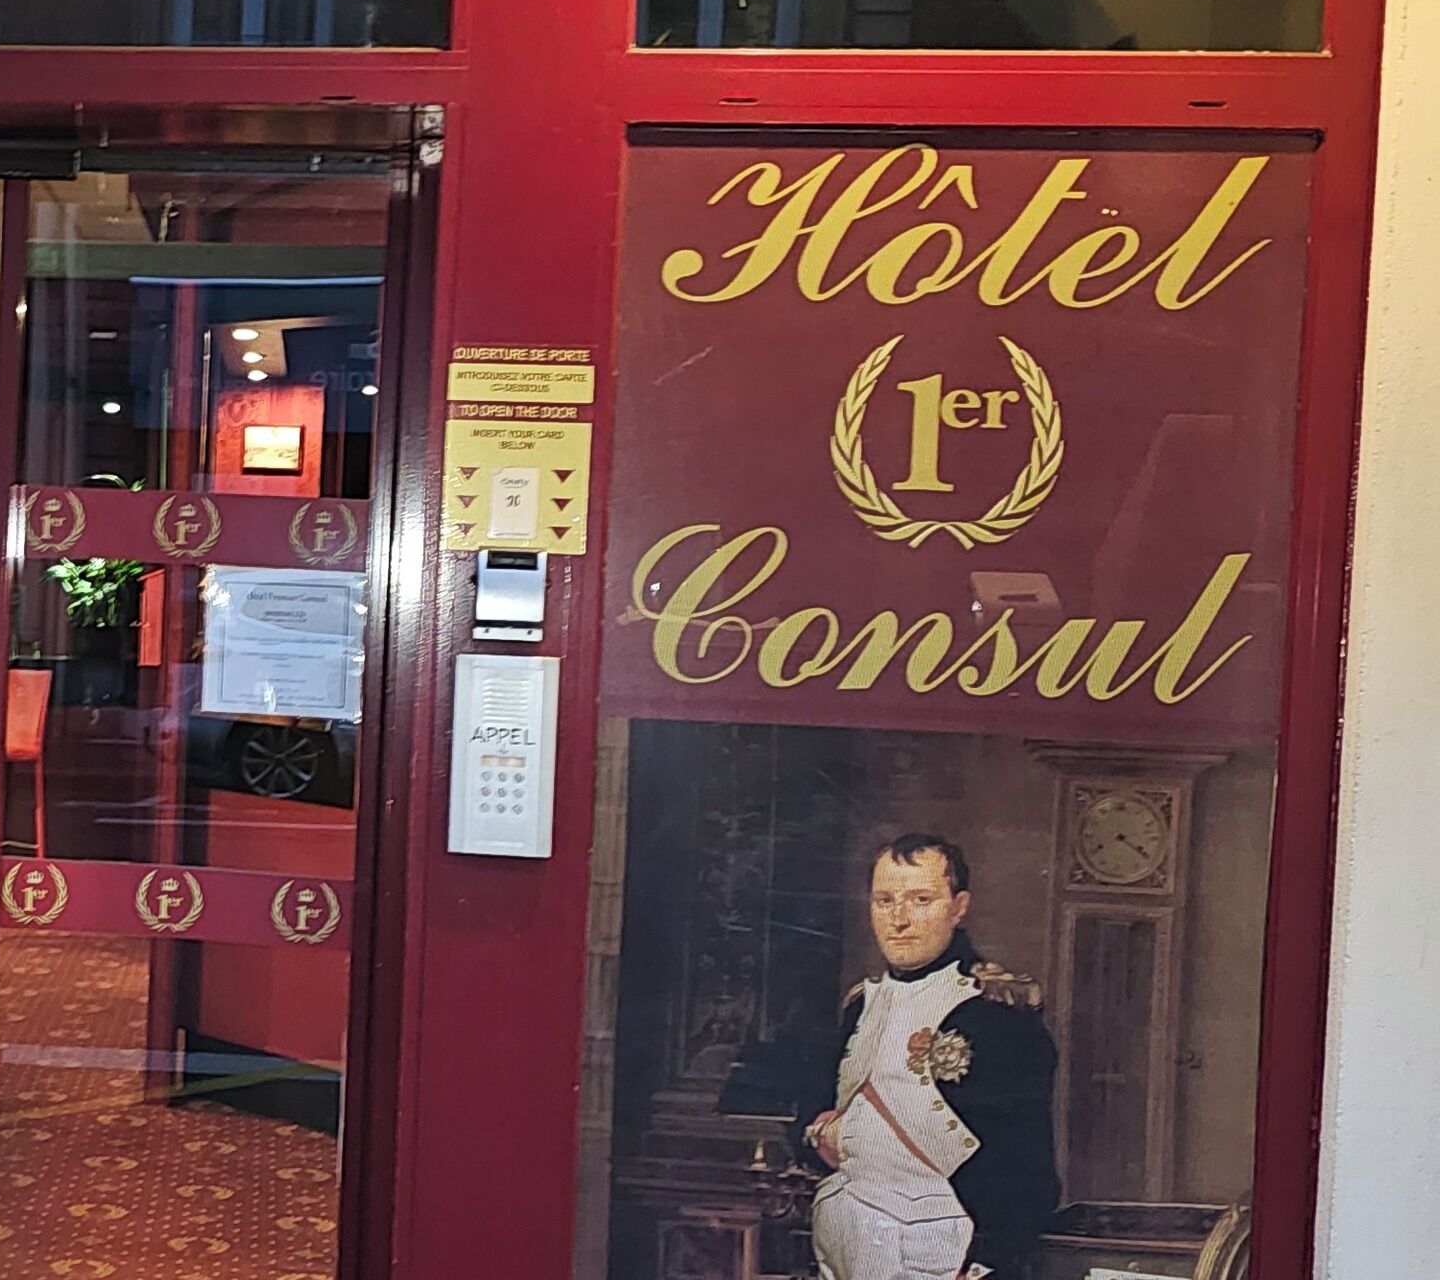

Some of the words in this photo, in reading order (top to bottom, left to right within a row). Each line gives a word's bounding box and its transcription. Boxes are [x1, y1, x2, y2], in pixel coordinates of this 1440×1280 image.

[662, 143, 1272, 310] Hôtel
[453, 347, 528, 360] OUVERTURE
[529, 349, 548, 361] DE
[549, 350, 591, 362] PORTE
[459, 405, 479, 416] TO
[479, 405, 513, 417] OPEN
[515, 406, 539, 418] THE
[540, 407, 577, 418] DOOR
[892, 373, 1019, 492] 1er
[632, 524, 1253, 704] Consul
[469, 726, 537, 746] APPEL
